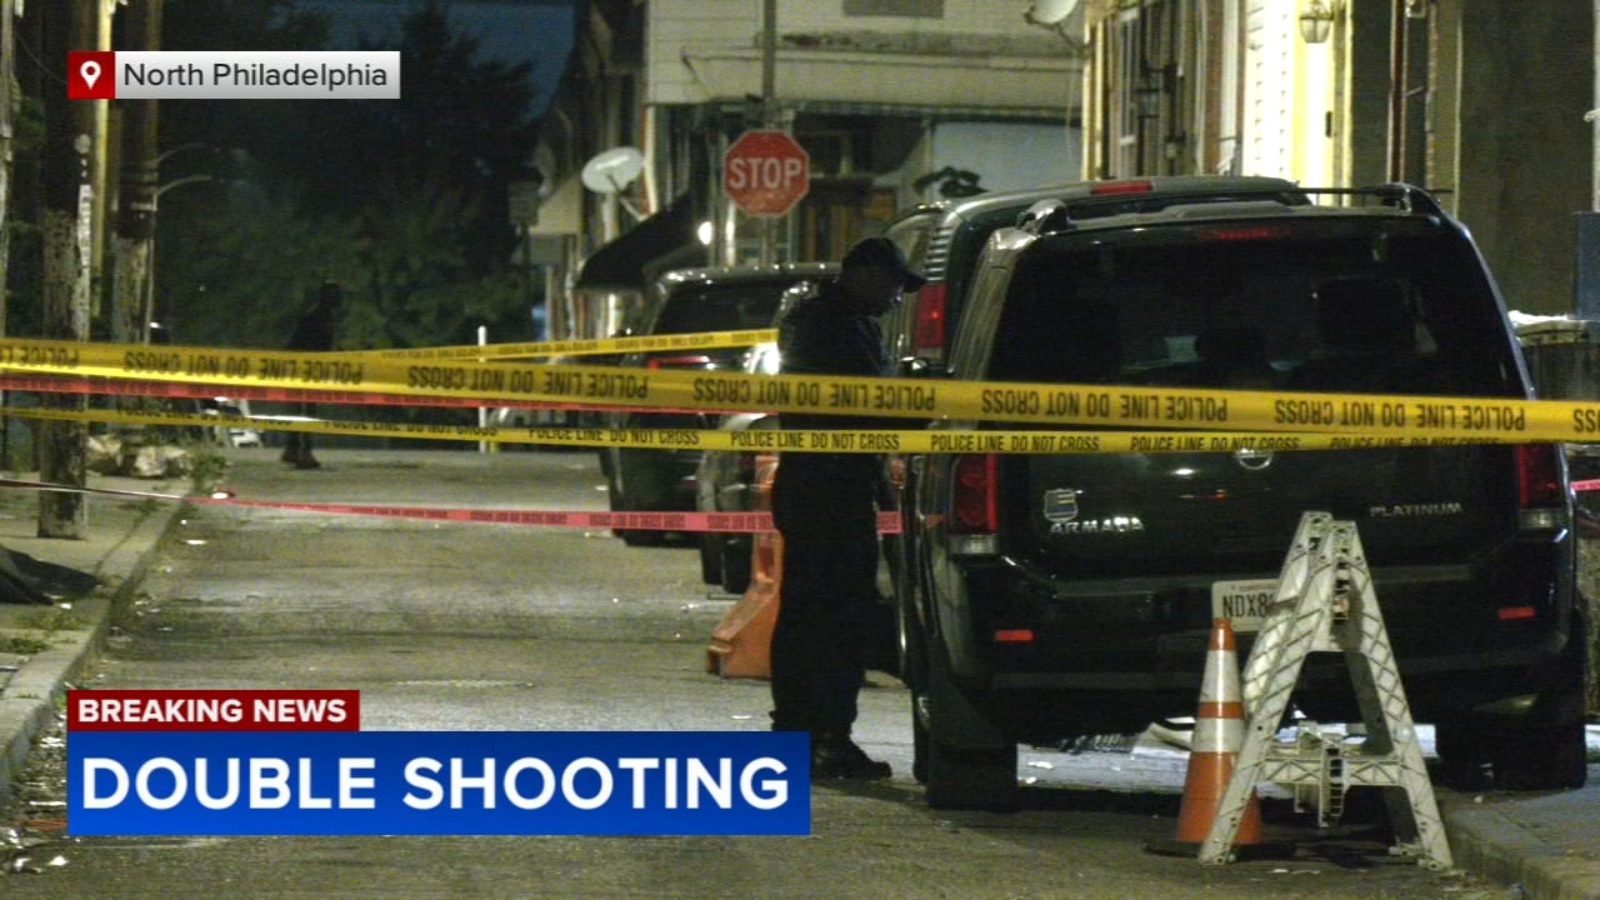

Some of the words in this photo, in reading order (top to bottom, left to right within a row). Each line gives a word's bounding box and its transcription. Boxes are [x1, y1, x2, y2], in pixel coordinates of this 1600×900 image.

[729, 157, 802, 189] STOP
[123, 351, 181, 375] CROSS
[186, 354, 220, 377] NOT
[226, 356, 248, 379] DO
[259, 358, 297, 380] LINE
[303, 359, 363, 385] POLICE
[408, 365, 465, 389] CROSS
[470, 368, 505, 391] NOT
[510, 370, 534, 393] DO
[543, 371, 582, 395] LINE
[586, 373, 648, 398] POLICE
[693, 378, 750, 402] CROSS
[756, 380, 790, 404] NOT
[797, 382, 820, 406] DO
[829, 383, 868, 408] LINE
[874, 385, 936, 411] POLICE
[981, 389, 1040, 414] CROSS
[1045, 391, 1080, 417] NOT
[1086, 393, 1110, 418] DO
[1120, 394, 1160, 419] LINE
[1165, 396, 1228, 422] POLICE
[1274, 399, 1334, 425] CROSS
[1340, 401, 1375, 426] NOT
[1382, 402, 1405, 427] DO
[1415, 403, 1456, 429] LINE
[1463, 405, 1526, 431] POLICE
[1573, 408, 1600, 433] SS
[575, 429, 604, 442] LINE
[610, 430, 628, 443] DO
[631, 430, 655, 444] NOT
[658, 430, 699, 445] CROSS
[730, 432, 774, 447] POLICE
[777, 432, 805, 448] LINE
[810, 433, 828, 448] DO
[831, 433, 855, 449] NOT
[859, 433, 900, 450] CROSS
[931, 435, 974, 450] POLICE
[977, 435, 1005, 450] LINE
[1011, 435, 1028, 451] DO
[1031, 436, 1056, 451] NOT
[1059, 436, 1100, 450] CROSS
[1130, 436, 1174, 450] POLICE
[1177, 436, 1205, 450] LINE
[1210, 437, 1228, 450] DO
[1231, 437, 1256, 450] NOT
[1259, 437, 1301, 450] CROSS
[1370, 502, 1462, 517] PLATINUM
